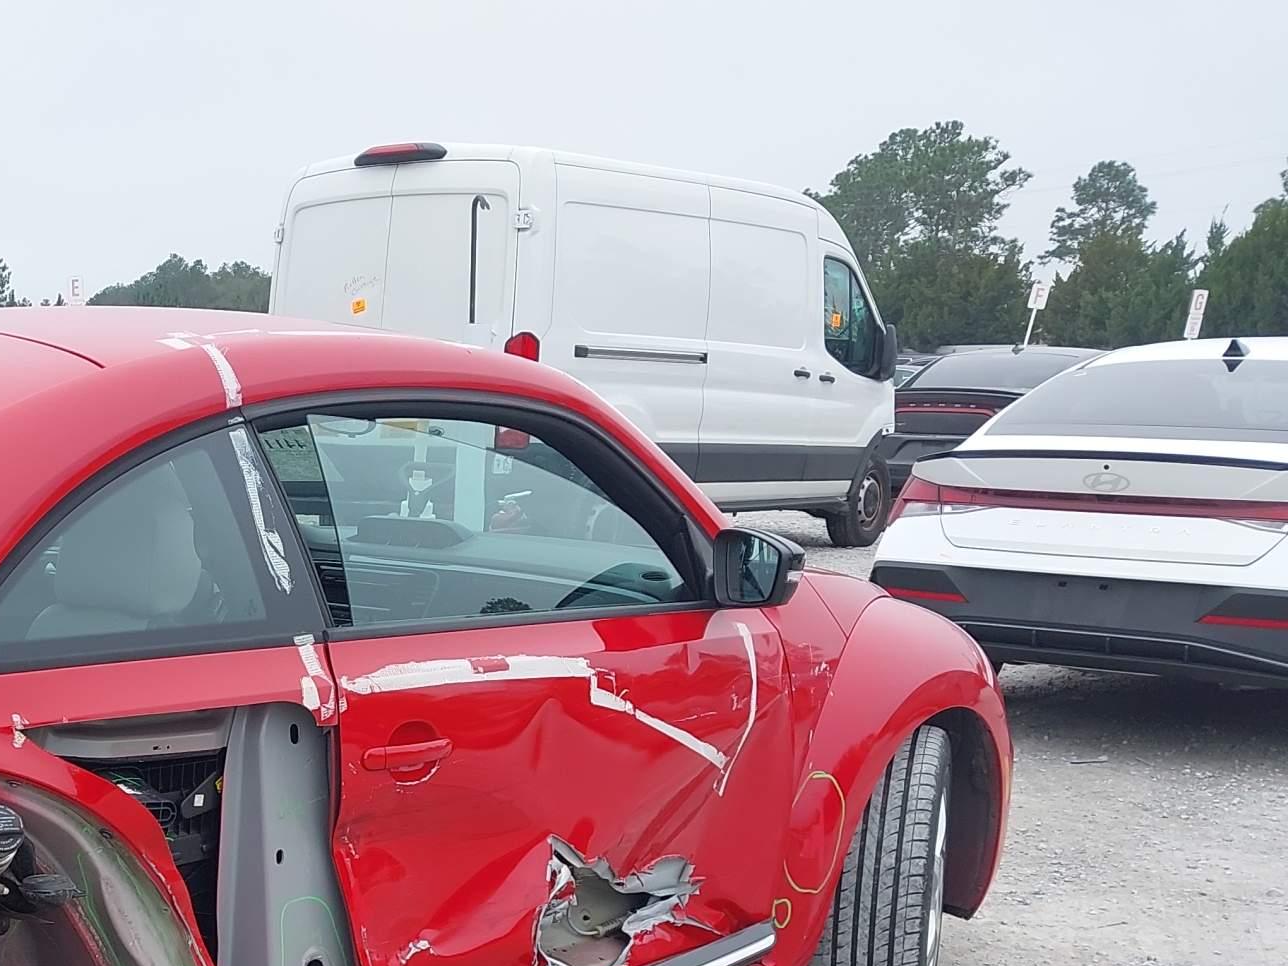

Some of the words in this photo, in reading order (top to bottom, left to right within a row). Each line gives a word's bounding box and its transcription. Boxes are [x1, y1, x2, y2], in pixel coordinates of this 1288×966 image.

[71, 278, 80, 297] E
[1034, 287, 1046, 305] F
[1195, 293, 1205, 311] G
